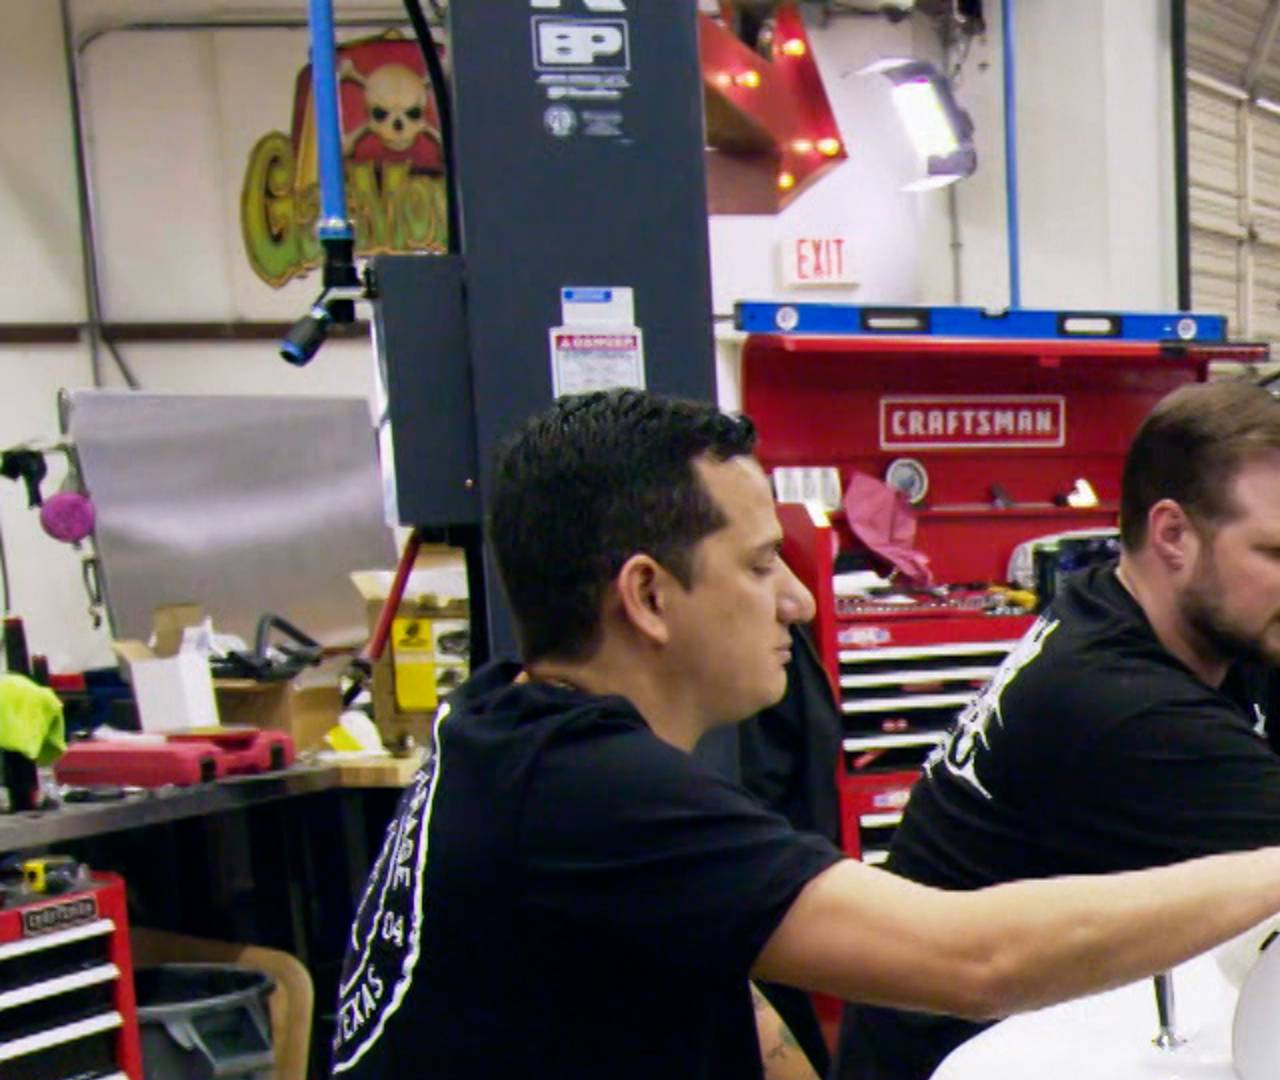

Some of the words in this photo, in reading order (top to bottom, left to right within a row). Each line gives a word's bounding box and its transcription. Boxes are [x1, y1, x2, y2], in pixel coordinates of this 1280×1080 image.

[539, 22, 622, 65] BP
[796, 238, 845, 279] EXIT
[891, 409, 1053, 436] CRAFTSMAN
